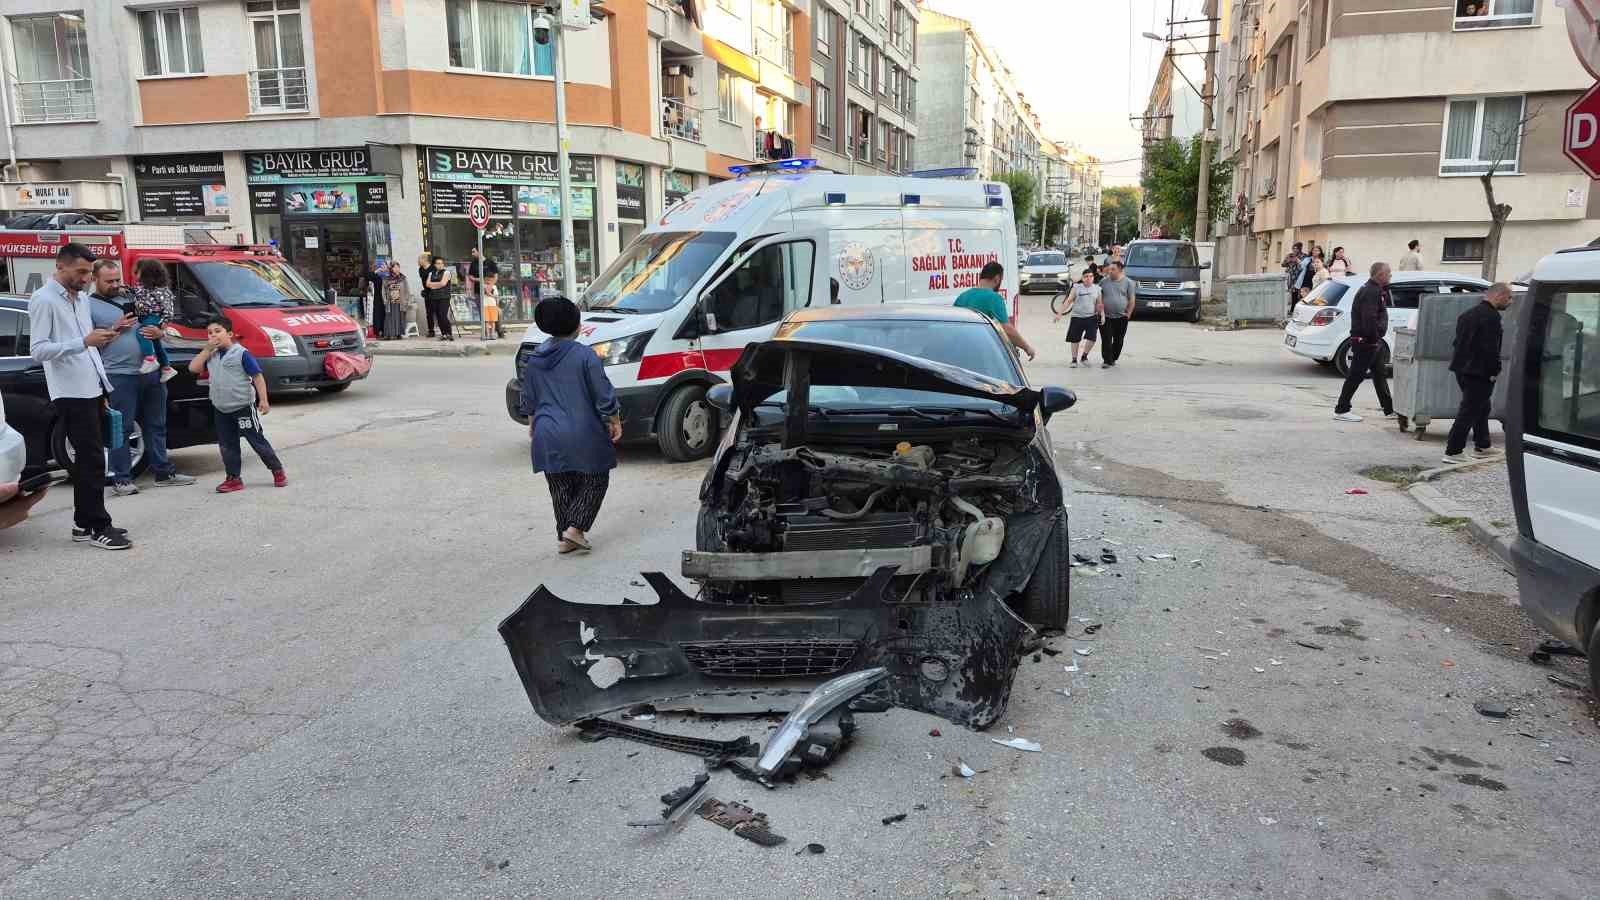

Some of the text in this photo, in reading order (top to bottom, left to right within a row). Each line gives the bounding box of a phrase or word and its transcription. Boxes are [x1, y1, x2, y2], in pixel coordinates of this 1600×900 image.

[264, 151, 365, 170] BAYIR GRUP
[455, 151, 513, 170] BAYIR
[473, 204, 486, 220] 30
[0, 243, 48, 255] YÜKŞEHİR
[947, 238, 965, 254] T.C.
[912, 253, 947, 271] SAĞLIK
[928, 270, 982, 290] ACİL SAĞLI
